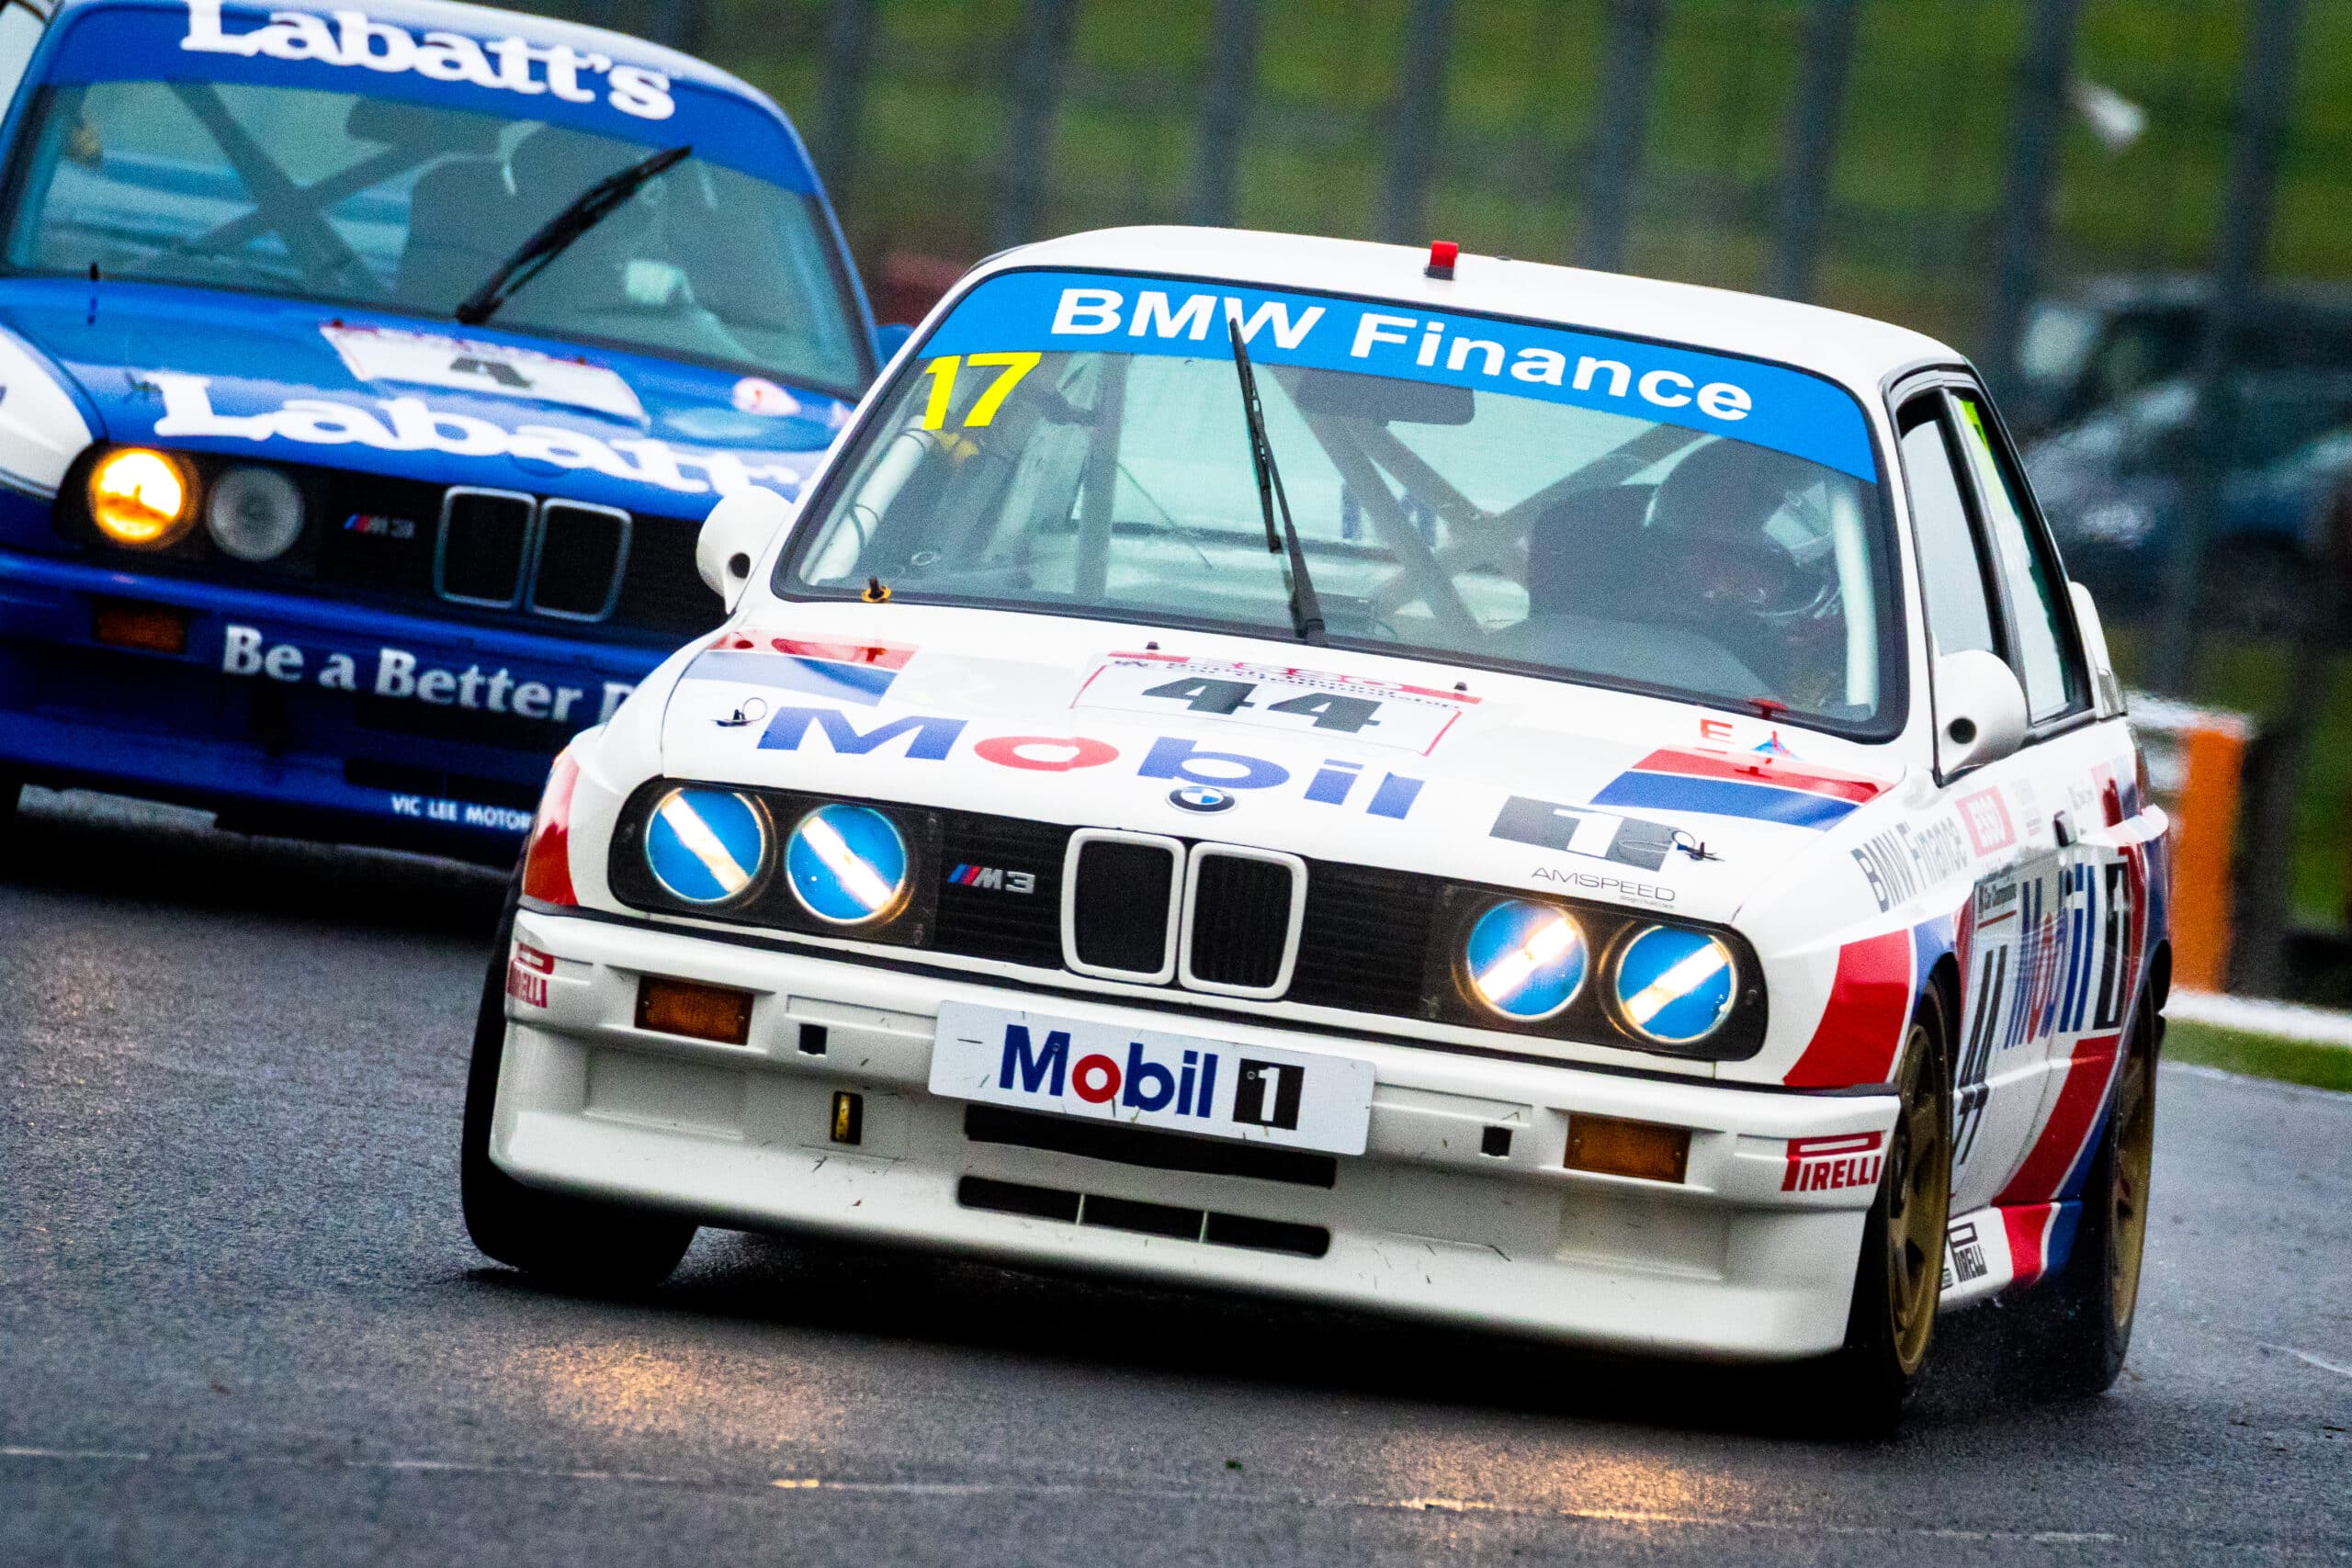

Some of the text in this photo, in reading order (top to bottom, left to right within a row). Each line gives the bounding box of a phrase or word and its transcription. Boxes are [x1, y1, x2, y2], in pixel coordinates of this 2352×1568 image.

[181, 0, 675, 120] Labatt's
[922, 351, 1042, 431] 17
[1051, 288, 1752, 421] BMW Finance
[222, 624, 302, 682] Be
[319, 652, 356, 693] a
[375, 647, 582, 724] Better
[1142, 676, 1383, 734] 44
[757, 706, 1426, 820] Mobil
[391, 793, 421, 817] VIC
[427, 800, 458, 822] LEE
[965, 864, 1035, 895] M3
[1532, 867, 1676, 902] AMSPEED
[999, 1024, 1219, 1119] Mobil
[1781, 1129, 1883, 1192] PIRELLI
